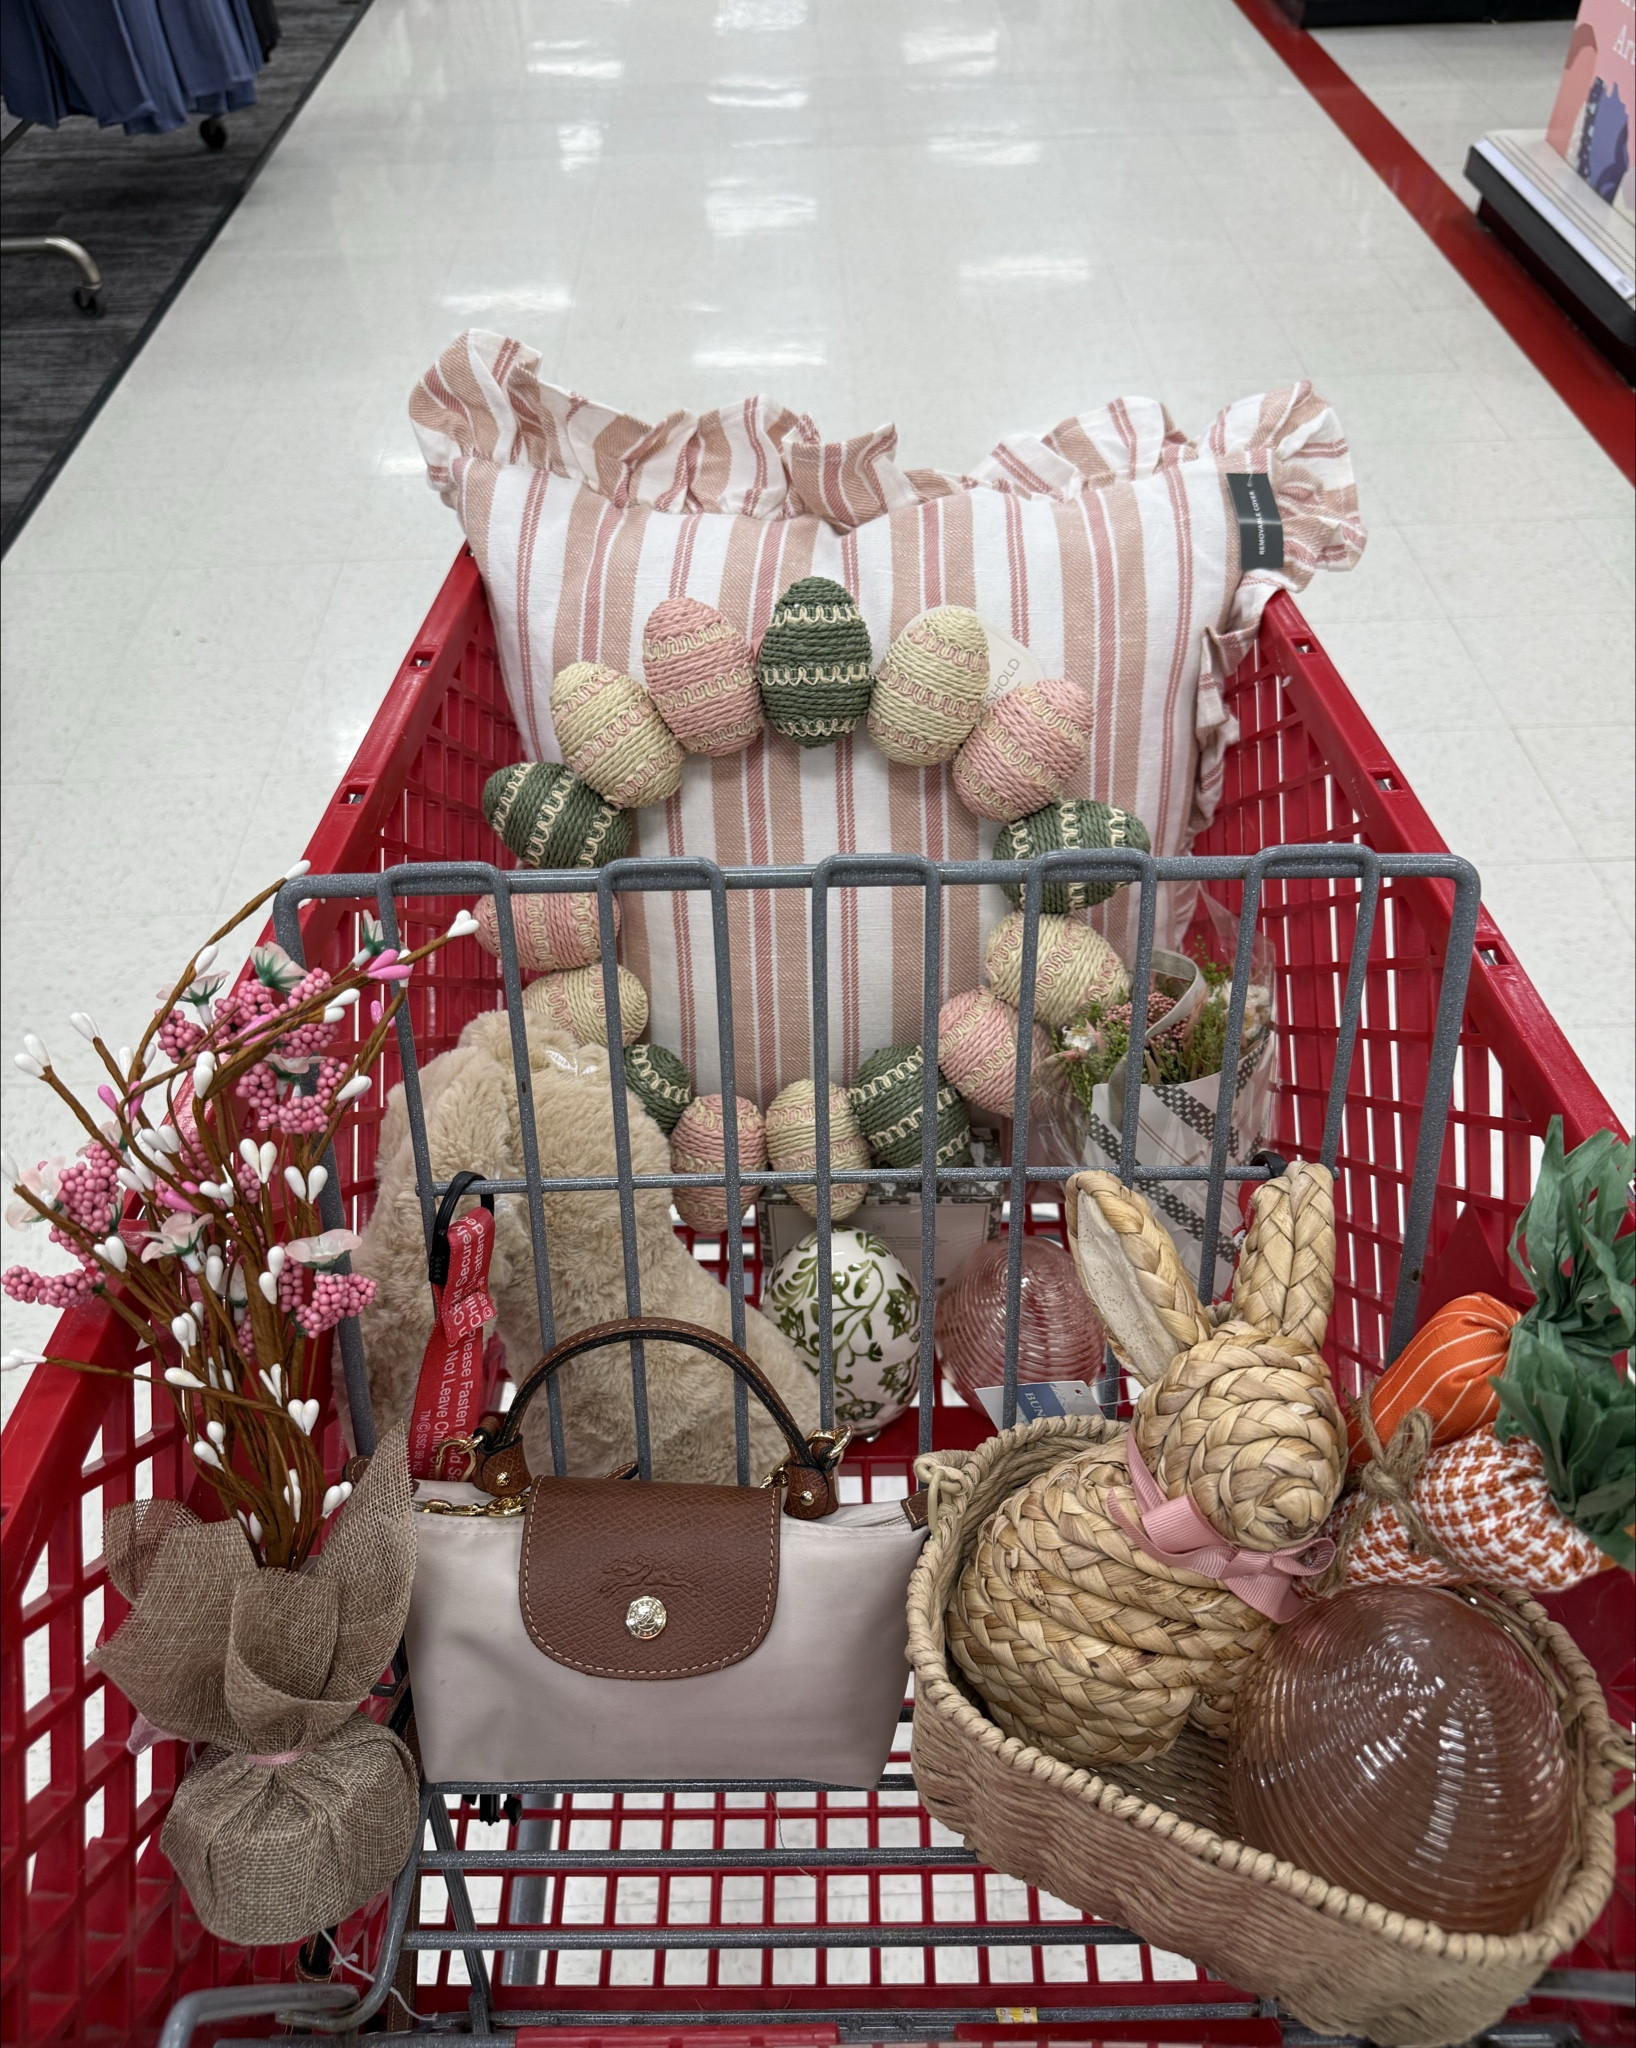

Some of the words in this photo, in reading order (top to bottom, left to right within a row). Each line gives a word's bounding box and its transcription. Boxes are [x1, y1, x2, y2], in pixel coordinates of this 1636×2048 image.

[1248, 490, 1260, 512] COVER
[1256, 512, 1266, 555] REMOVABLE
[453, 1225, 472, 1288] Securely
[451, 1288, 464, 1325] Chld
[465, 1293, 482, 1328] Chil
[443, 1350, 459, 1377] Not
[461, 1329, 476, 1377] Please
[436, 1378, 456, 1418] Leave
[454, 1380, 474, 1427] Fasten
